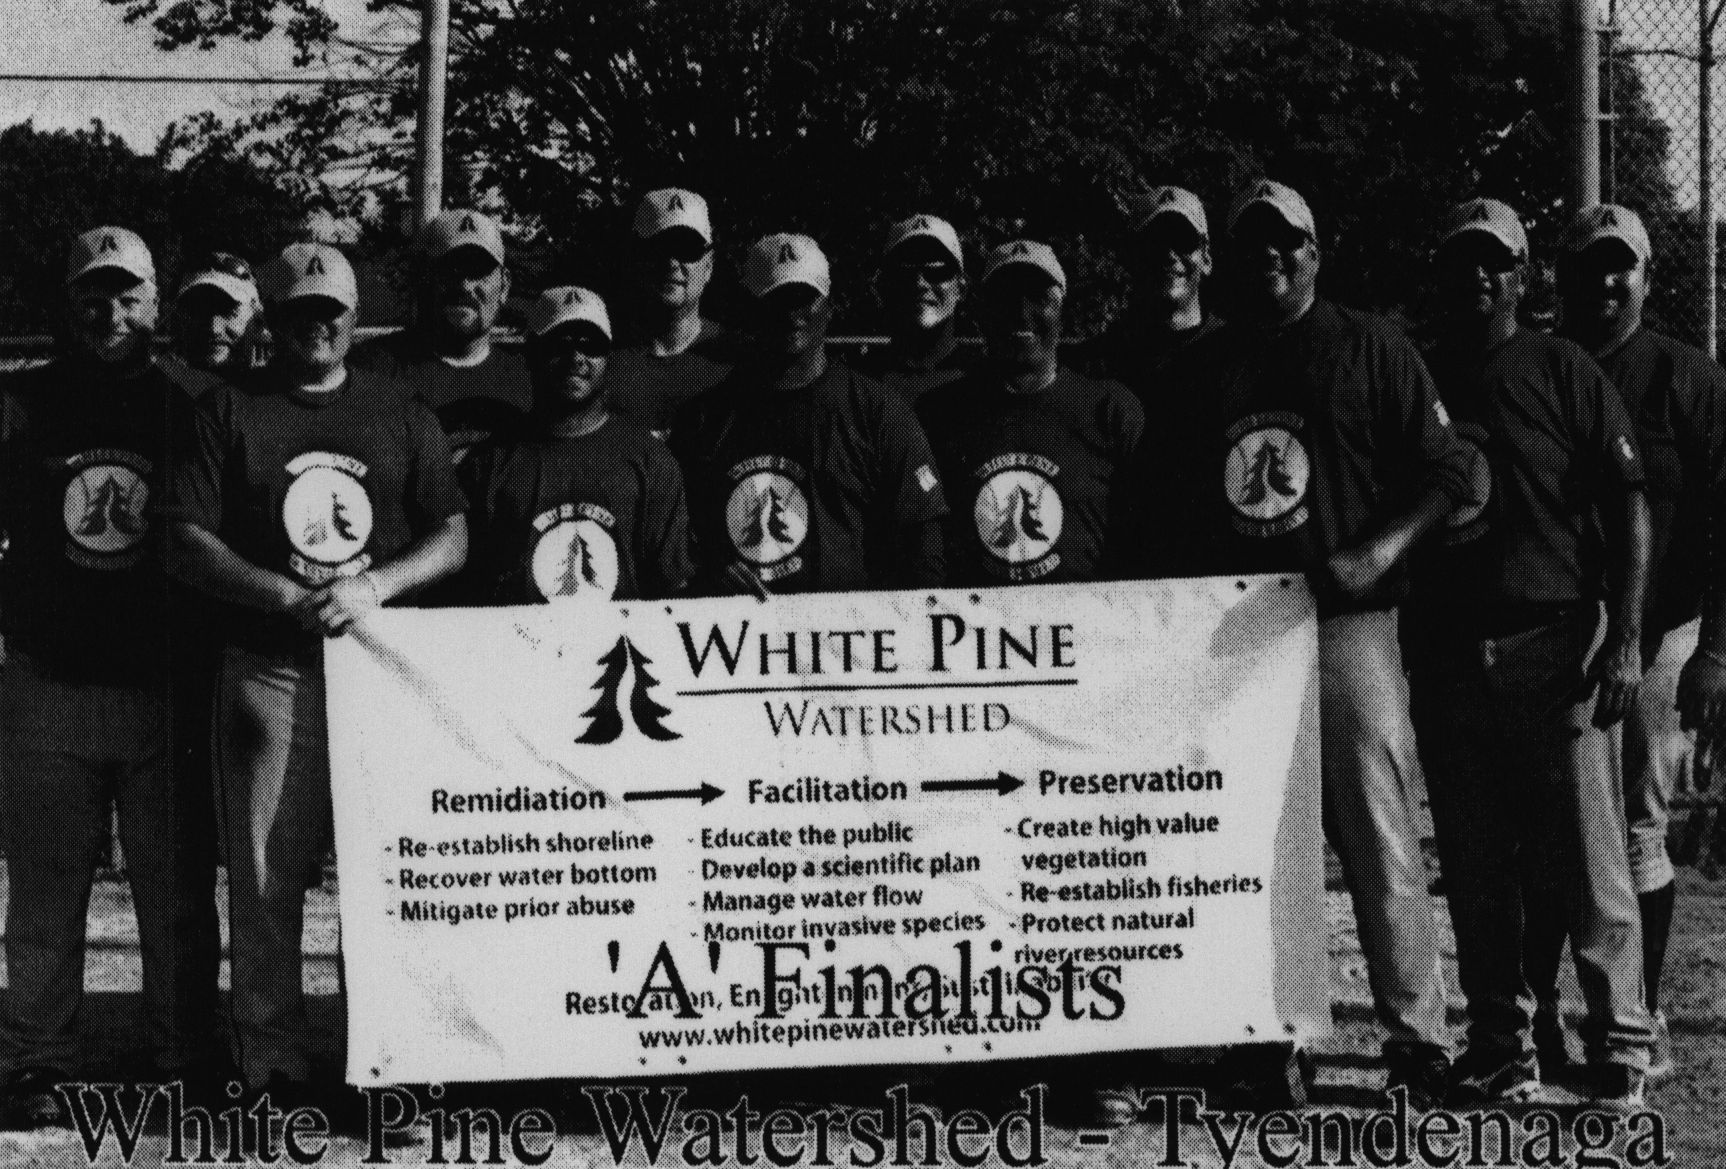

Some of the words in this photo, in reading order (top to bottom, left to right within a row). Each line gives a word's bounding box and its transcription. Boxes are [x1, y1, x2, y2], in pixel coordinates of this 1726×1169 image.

[677, 621, 897, 677] WHITE
[930, 614, 1075, 671] PINE
[764, 701, 1010, 735] WATERSHED
[749, 776, 907, 803] Facilitation
[1040, 765, 1222, 795] Preservation
[432, 787, 606, 813] Remidiation
[702, 829, 791, 848] Educate
[799, 826, 836, 845] the
[844, 822, 912, 848] public
[1018, 818, 1092, 838] Create
[1100, 814, 1151, 841] high
[1157, 813, 1219, 833] value
[399, 834, 539, 856] Re-establish
[547, 831, 653, 852] shoreline
[702, 857, 797, 882] Develop
[803, 862, 815, 877] a
[822, 853, 923, 877] scientific
[930, 853, 979, 878] plan
[1022, 848, 1146, 874] vegetation
[400, 870, 490, 888] Recover
[499, 869, 563, 885] water
[571, 864, 656, 884] bottom
[1021, 877, 1161, 902] Re-establish
[1168, 875, 1262, 896] fisheries
[401, 901, 497, 924] Mitigate
[504, 896, 560, 923] prior
[567, 896, 634, 915] abuse
[703, 891, 794, 915] Manage
[801, 890, 866, 908] water
[873, 885, 922, 906] flow
[704, 921, 796, 942] Monitor
[803, 917, 895, 937] invasive
[902, 911, 986, 938] species
[1022, 914, 1104, 933] Protect
[1113, 907, 1194, 930] natural
[1014, 943, 1069, 964] river
[1072, 944, 1184, 963] resources
